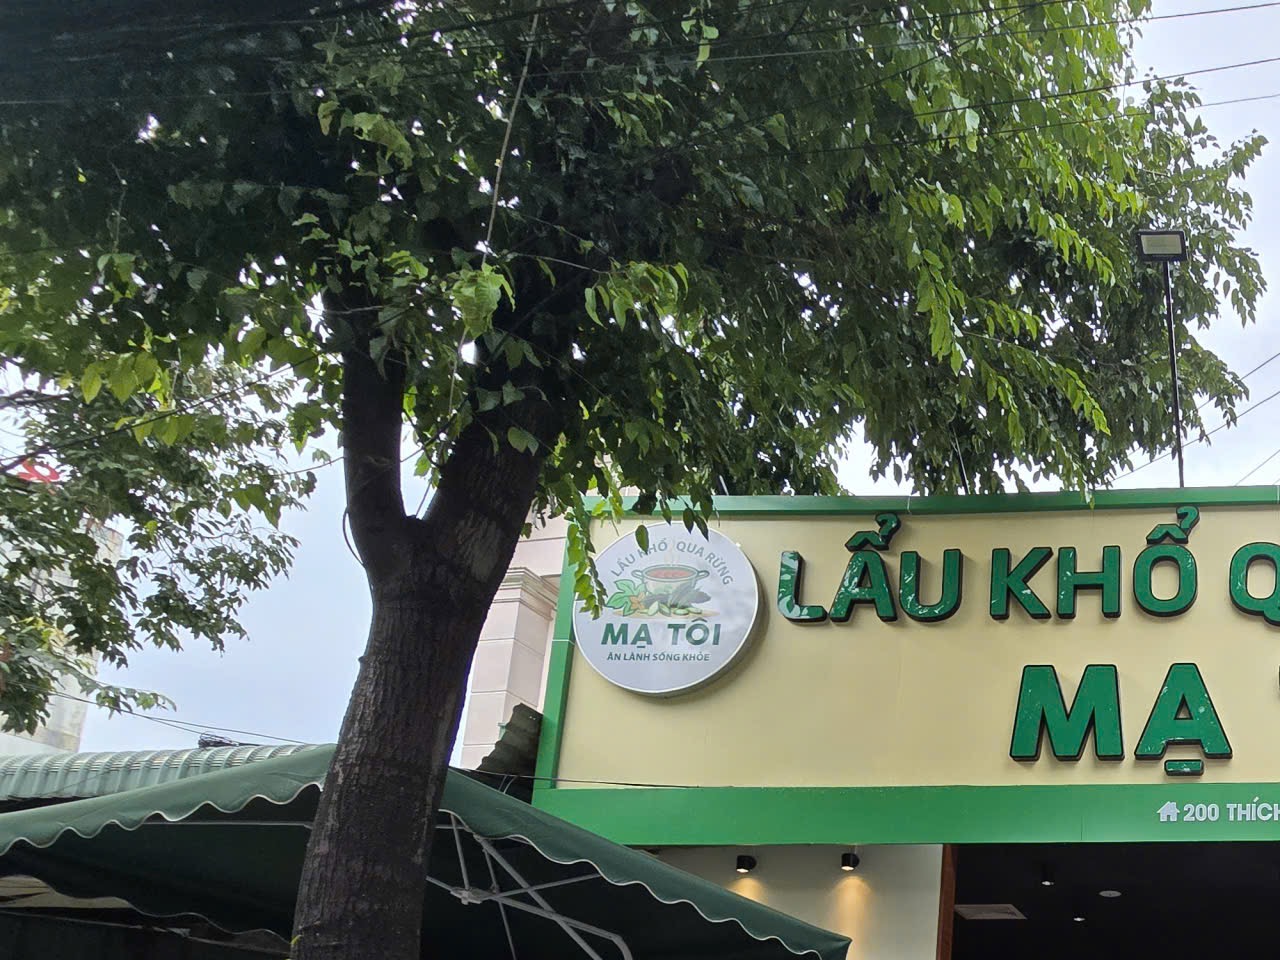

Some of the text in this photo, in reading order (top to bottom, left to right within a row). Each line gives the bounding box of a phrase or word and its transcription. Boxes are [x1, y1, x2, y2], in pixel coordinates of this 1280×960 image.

[676, 540, 705, 557] QUA
[777, 513, 964, 622] LẨU
[991, 507, 1199, 620] KHỔ
[601, 617, 722, 648] MẠ TÔI
[623, 651, 651, 661] LÀNH
[1009, 661, 1234, 777] MẠ
[1184, 803, 1220, 821] 200
